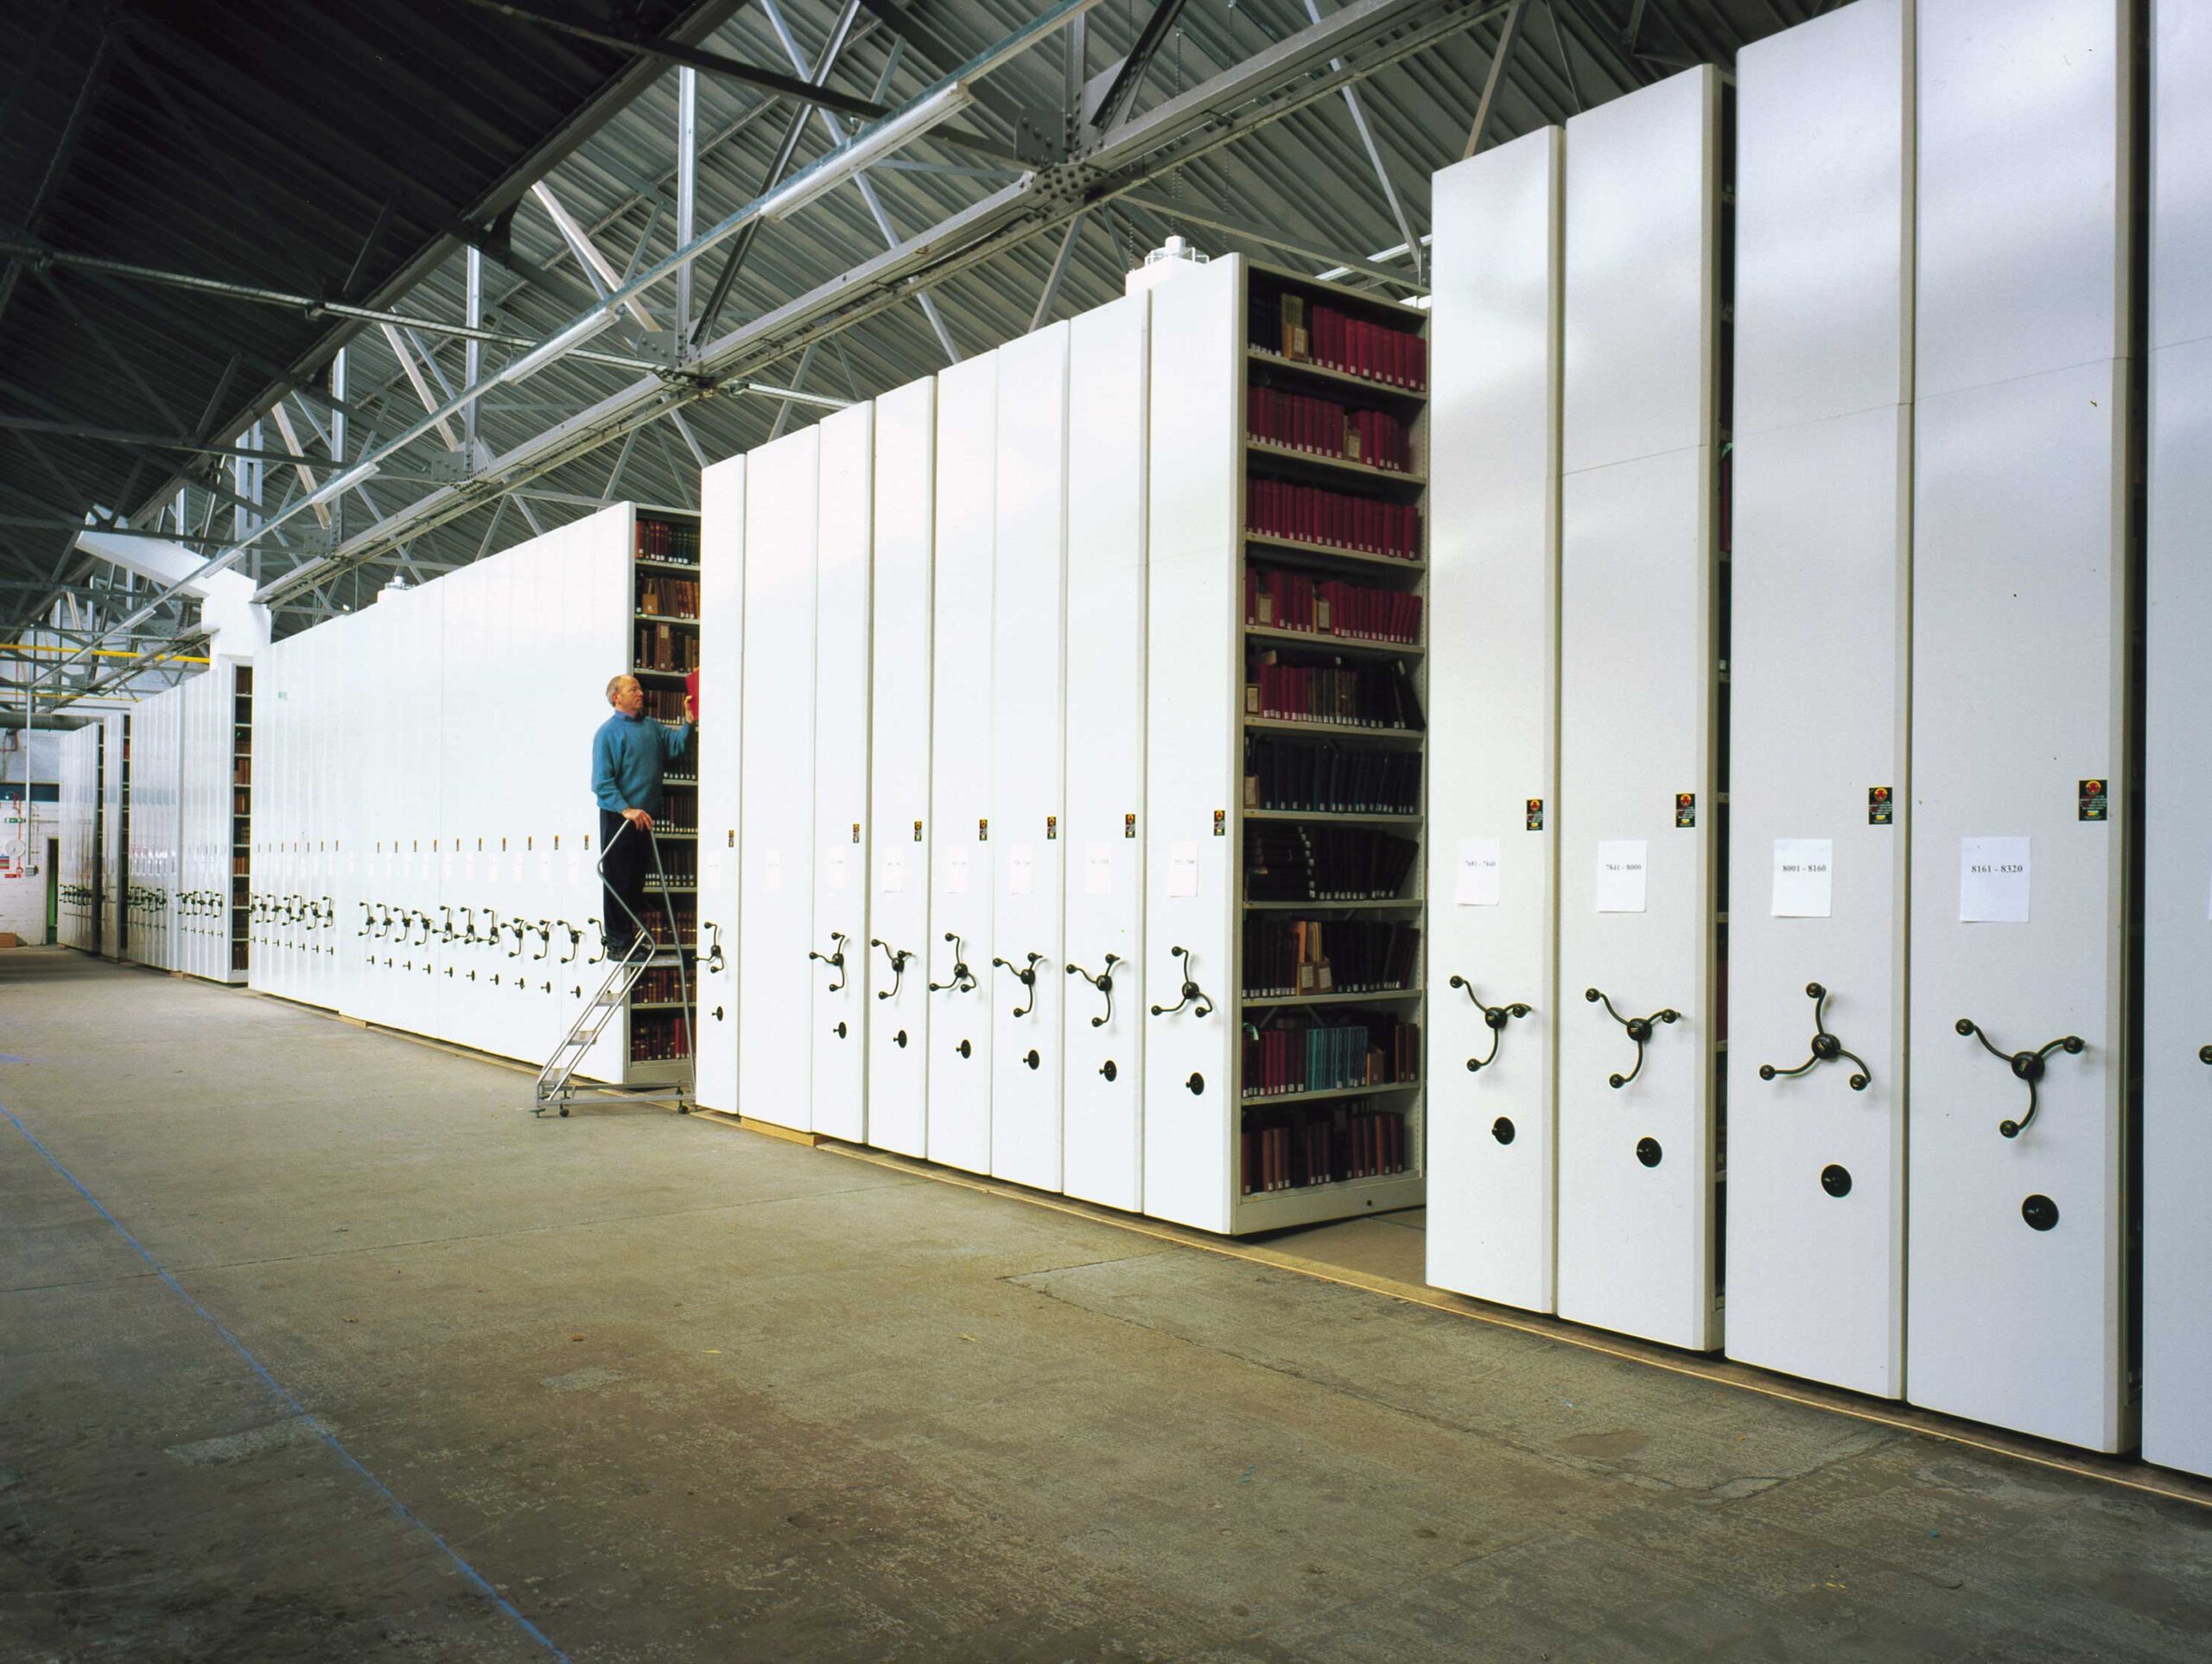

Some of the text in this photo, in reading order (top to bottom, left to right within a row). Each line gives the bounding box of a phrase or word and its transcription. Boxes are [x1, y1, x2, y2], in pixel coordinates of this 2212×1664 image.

[1783, 864, 1800, 873] 8001
[1808, 864, 1827, 873] 8160
[1971, 864, 1992, 873] 8161
[2000, 864, 2024, 873] 8320
